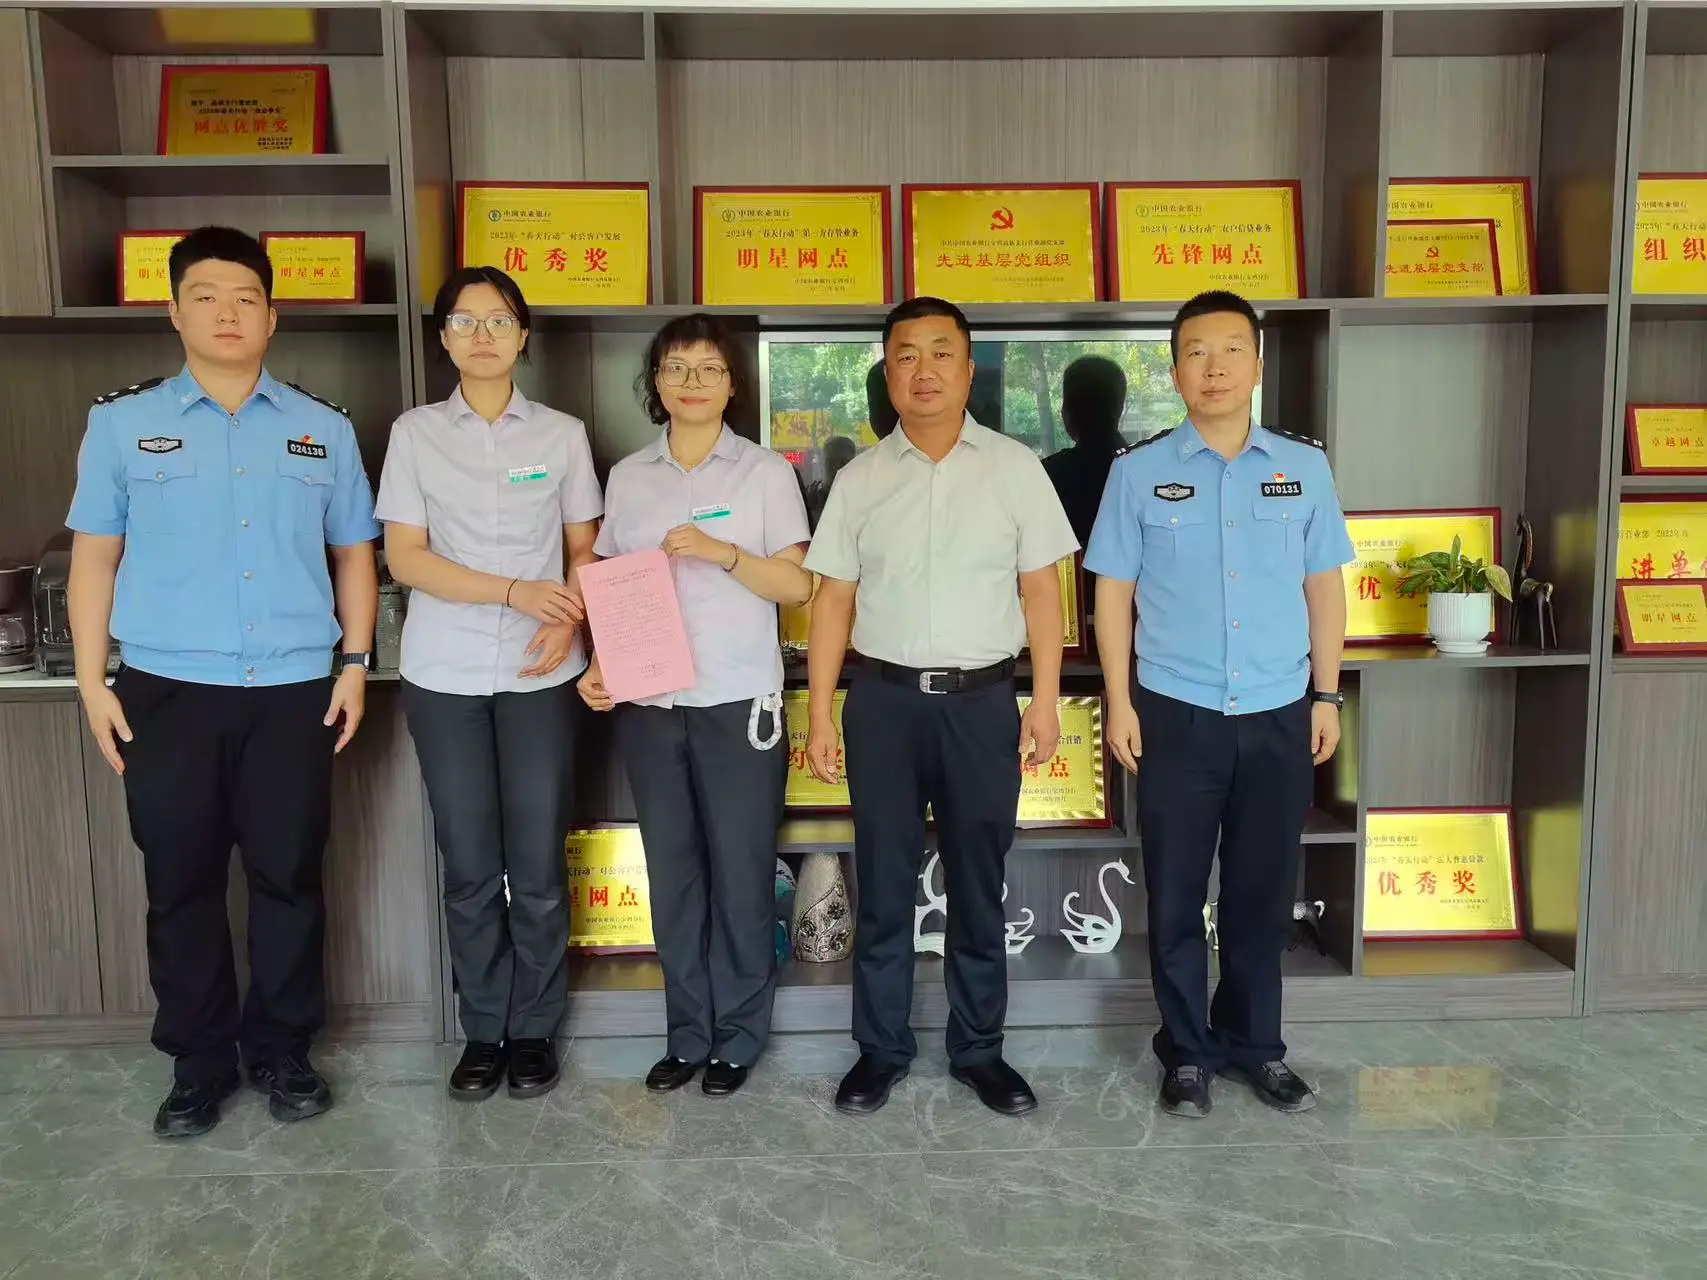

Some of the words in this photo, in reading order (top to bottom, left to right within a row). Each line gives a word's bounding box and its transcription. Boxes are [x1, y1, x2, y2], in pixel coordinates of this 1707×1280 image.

[502, 209, 552, 219] 中国农业银行
[738, 208, 791, 218] 中国农业银行
[1151, 205, 1203, 214] 中国农业银行
[1153, 242, 1265, 265] 先锋网点
[1643, 237, 1707, 262] 组织
[503, 246, 609, 273] 优秀奖
[736, 246, 850, 270] 明星网点
[935, 252, 1072, 268] 先进基层党组织
[280, 266, 341, 279] 明星网点
[1385, 261, 1486, 275] 先进基层党支部
[1264, 484, 1299, 494] 070131
[1378, 869, 1477, 897] 优秀奖
